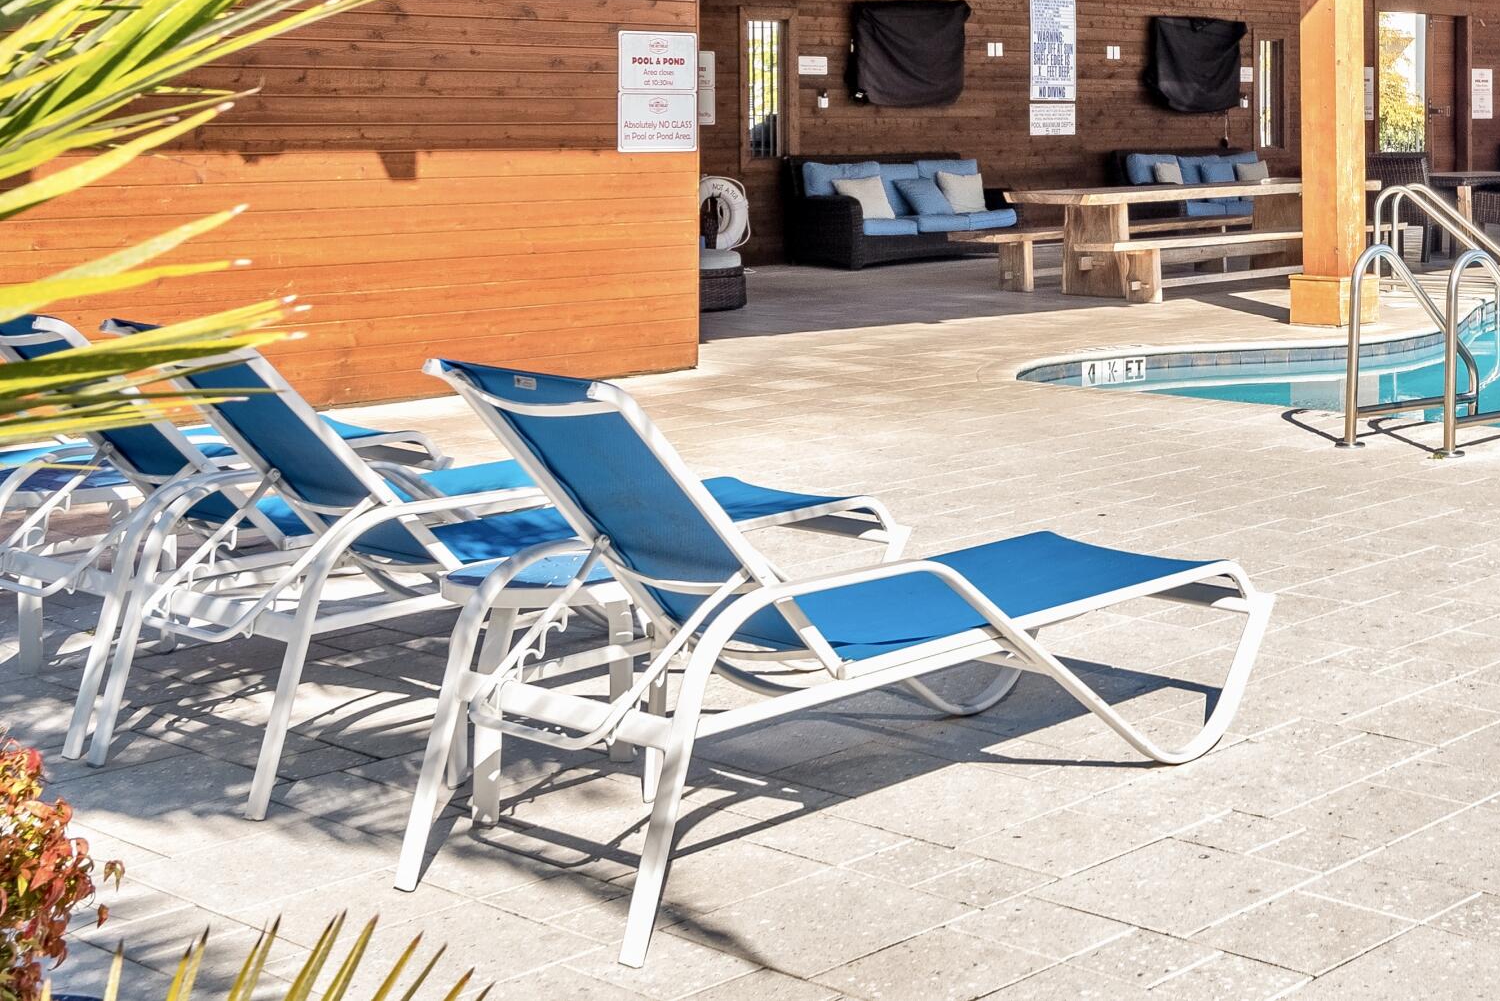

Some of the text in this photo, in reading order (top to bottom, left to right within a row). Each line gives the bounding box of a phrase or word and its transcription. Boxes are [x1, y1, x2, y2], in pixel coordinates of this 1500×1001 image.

[1034, 54, 1070, 66] SHELF EDGE IS
[1047, 66, 1057, 77] FEET
[1039, 87, 1065, 97] NO DIVING
[624, 121, 657, 130] Absolutely
[712, 183, 724, 191] NOT
